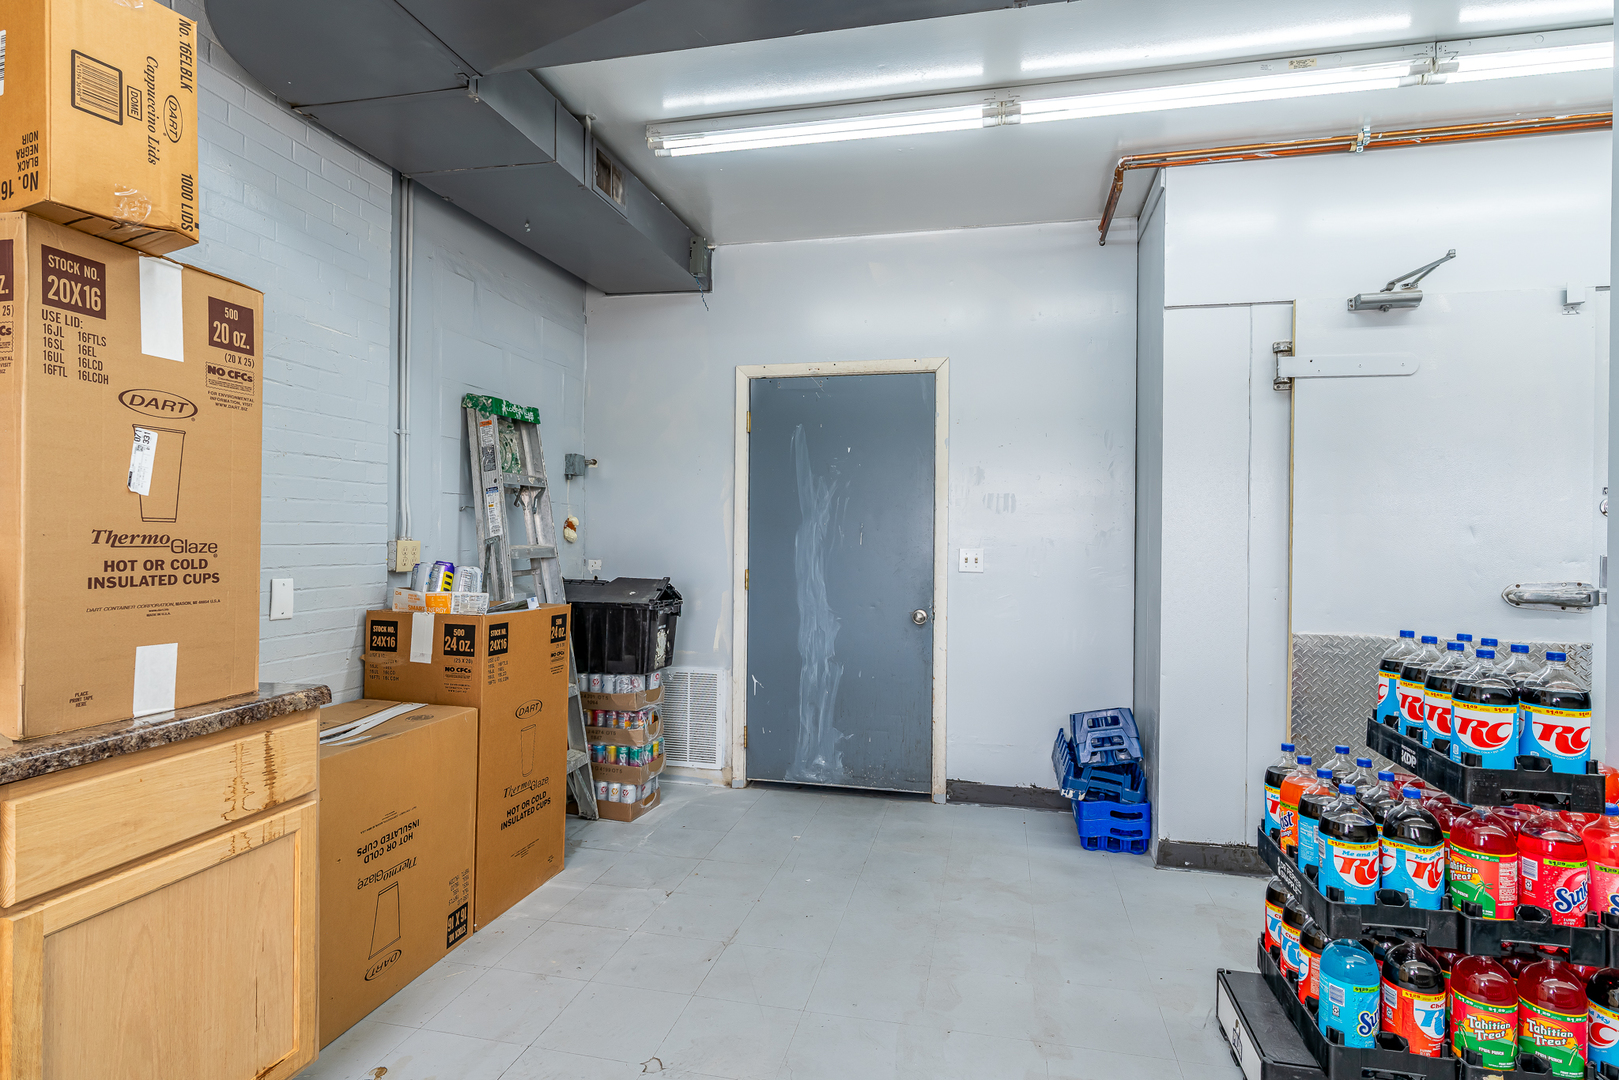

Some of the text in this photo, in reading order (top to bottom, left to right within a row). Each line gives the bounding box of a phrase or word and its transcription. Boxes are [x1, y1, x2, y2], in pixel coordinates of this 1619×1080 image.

[178, 18, 193, 93] No. 16ELBLK
[130, 90, 139, 116] DOME
[144, 56, 160, 165] Cappuccino Lids
[168, 100, 178, 138] DART
[22, 130, 38, 145] NOIR
[16, 143, 38, 160] NEGRA
[17, 156, 38, 172] BLACK
[181, 173, 193, 232] 1000 LIDS
[48, 254, 100, 281] STOCK NO.
[47, 275, 102, 312] 20X16
[41, 308, 83, 330] USE LID:
[224, 307, 239, 320] 500
[43, 323, 107, 347] 16JL 16FTLS
[213, 320, 230, 344] 20
[43, 336, 97, 358] 16SL 16EL
[43, 350, 103, 372] 16UL 16LCD
[224, 352, 255, 369] (20 X 25)
[43, 363, 109, 385] 16FTL 16LCDH
[207, 364, 226, 377] NO
[227, 369, 253, 383] CFCs
[129, 394, 189, 414] DART
[218, 392, 254, 403] ENVIRONMENTAL
[103, 558, 209, 573] HOT OR COLD
[87, 572, 221, 590] INSULATED CUPS
[103, 604, 136, 612] CONTAINER
[373, 625, 387, 633] STOCK
[453, 628, 465, 636] 500
[551, 626, 558, 640] 24
[372, 635, 396, 648] 24X16
[444, 636, 457, 651] 24
[489, 638, 508, 652] 24X16
[518, 702, 540, 717] DART
[1455, 715, 1513, 748] RC
[1532, 721, 1591, 755] RC
[500, 797, 551, 831] INSULATED CUPS
[506, 791, 547, 818] HOT OR COLD
[380, 818, 420, 845] INSULATED
[356, 839, 379, 857] CUPS
[363, 832, 414, 864] HOT OR COLD
[1334, 854, 1380, 886] RC
[1406, 856, 1444, 889] RC
[1450, 860, 1479, 874] hitian
[1450, 870, 1472, 881] Treat
[1554, 880, 1588, 913] Sunk
[455, 911, 460, 927] X
[461, 906, 467, 922] 16
[368, 952, 398, 979] DART
[1466, 1013, 1511, 1030] Tahitian
[1526, 1017, 1574, 1038] Tahitian
[1474, 1029, 1506, 1041] Treat
[1533, 1033, 1568, 1046] Treat
